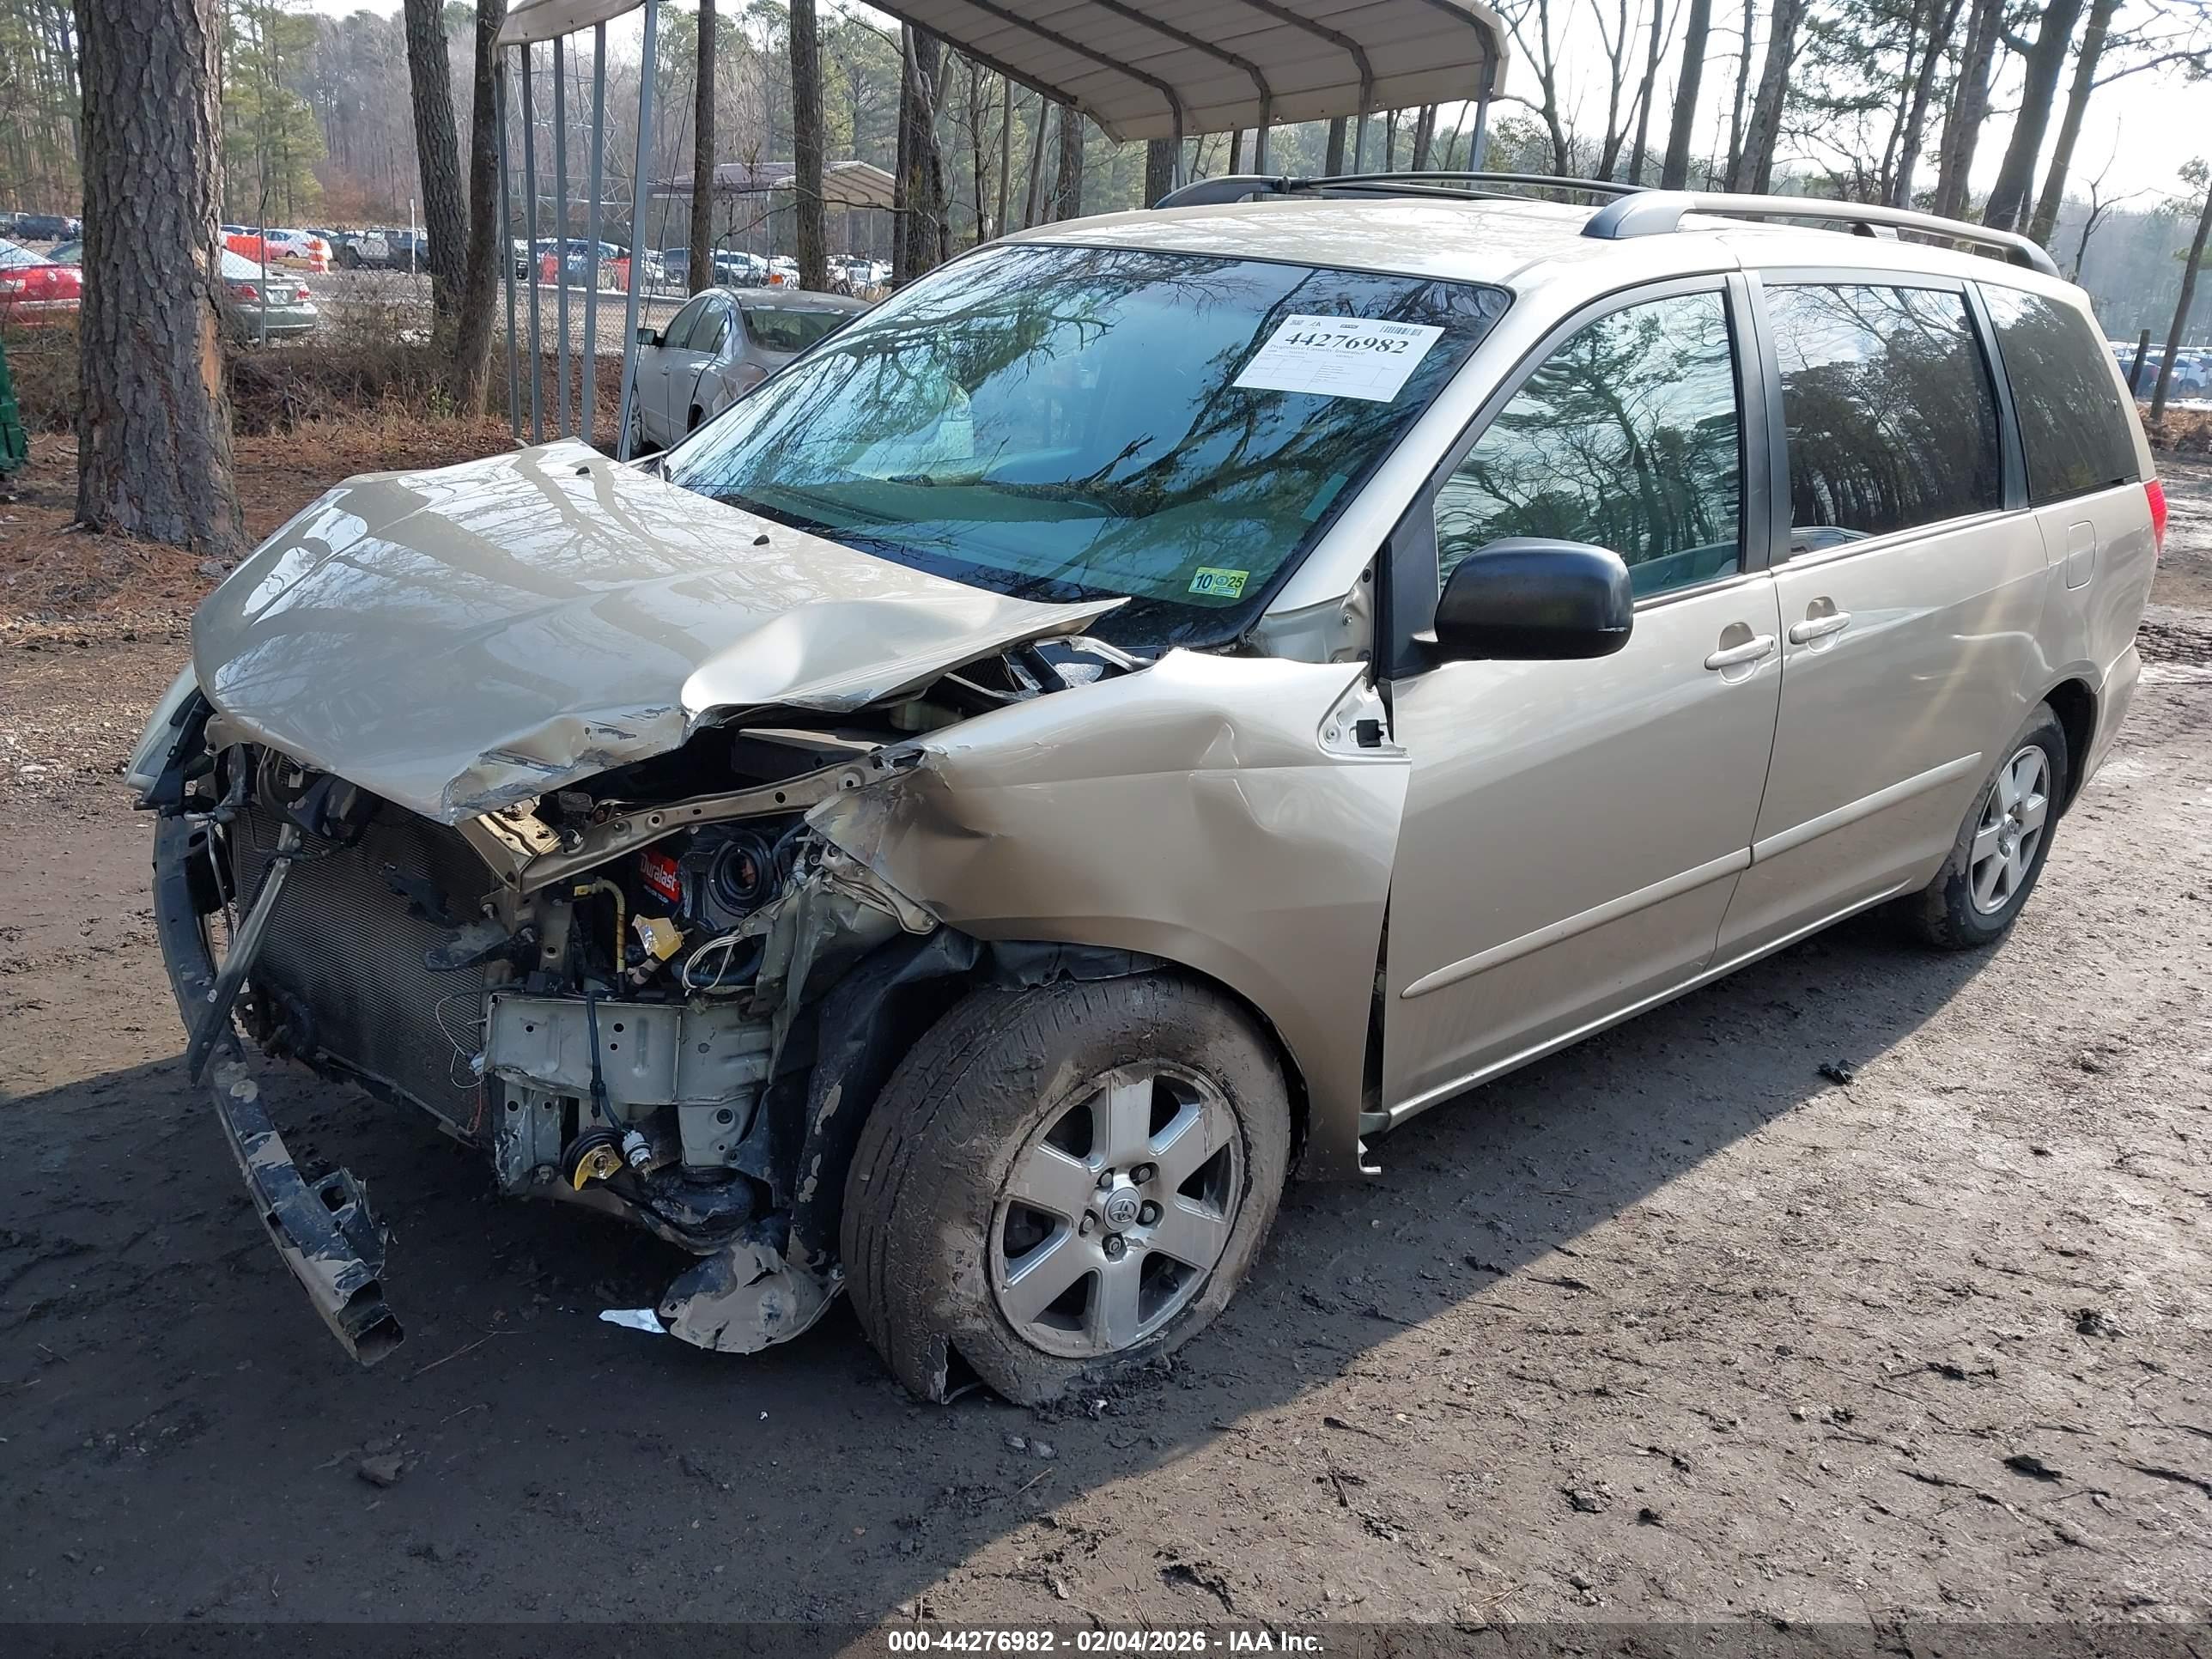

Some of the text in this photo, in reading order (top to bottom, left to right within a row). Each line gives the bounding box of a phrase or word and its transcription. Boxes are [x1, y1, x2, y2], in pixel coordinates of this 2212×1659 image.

[1285, 331, 1409, 354] 44276982
[1196, 574, 1244, 589] 10 25
[640, 852, 677, 891] Duralast
